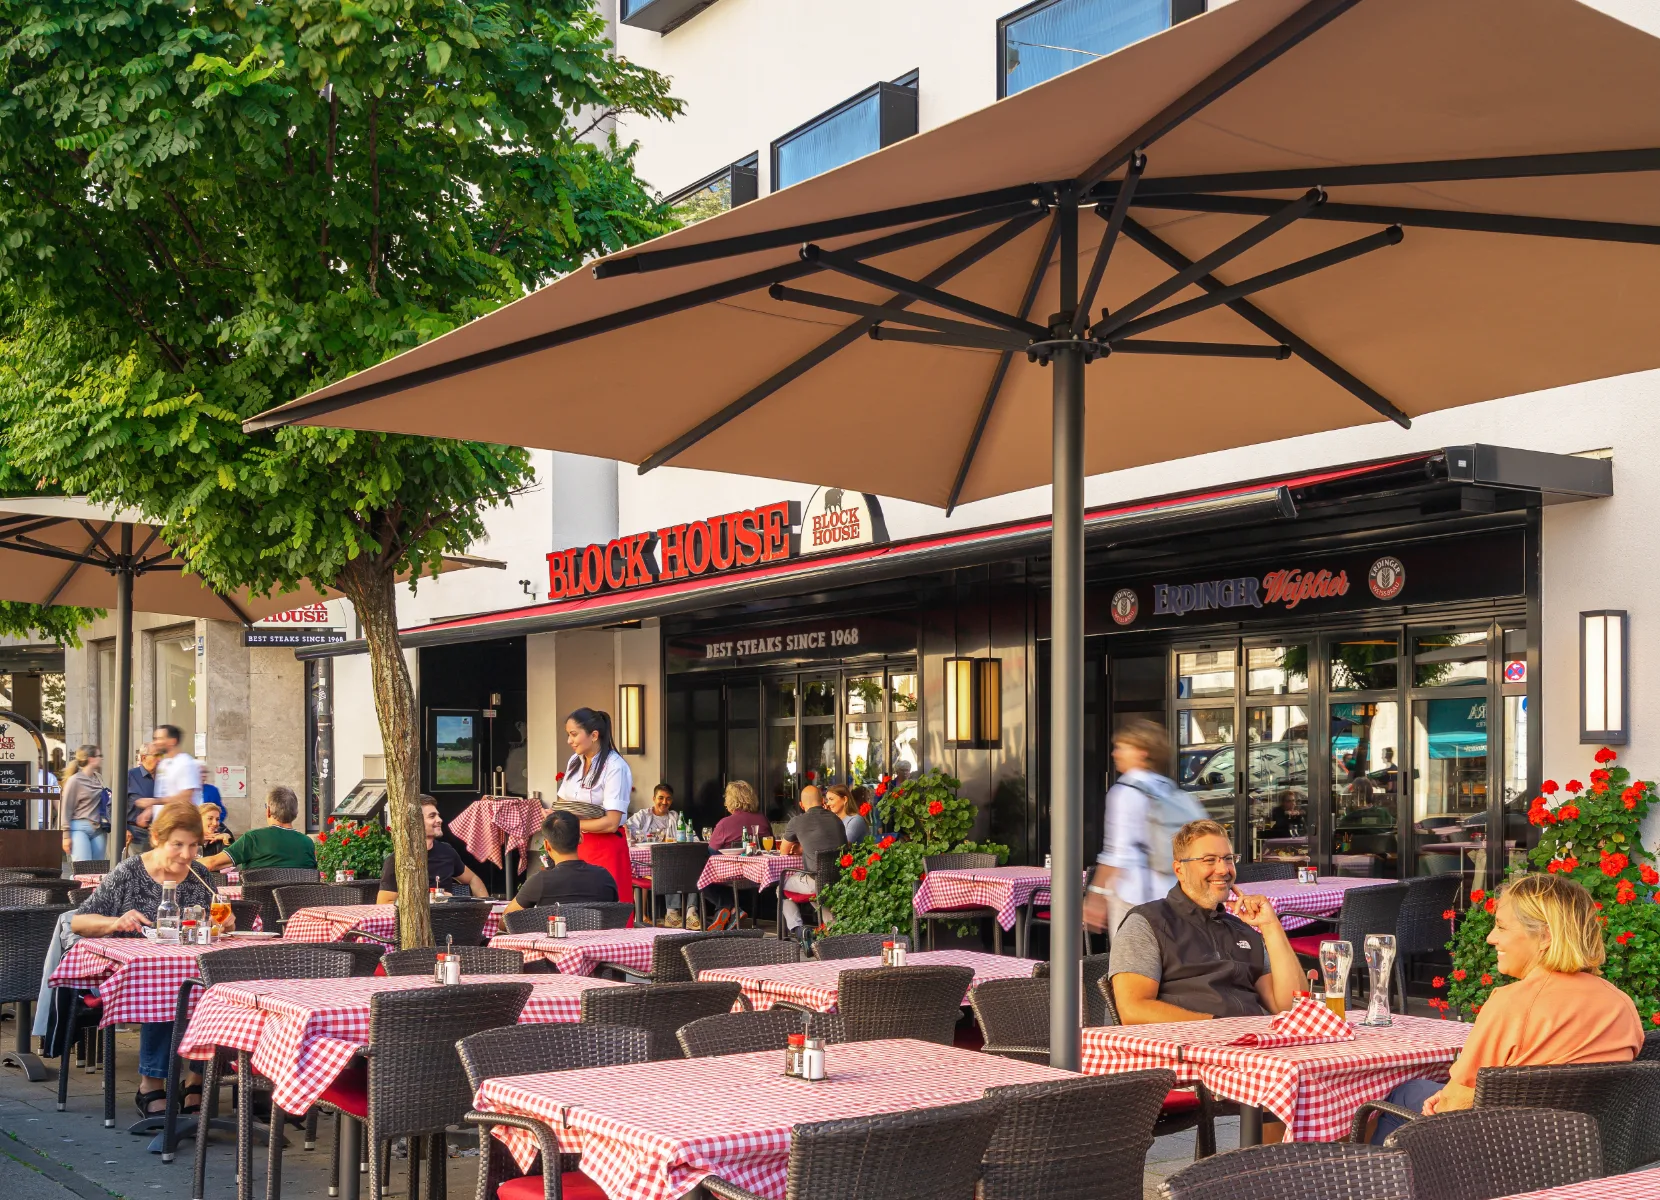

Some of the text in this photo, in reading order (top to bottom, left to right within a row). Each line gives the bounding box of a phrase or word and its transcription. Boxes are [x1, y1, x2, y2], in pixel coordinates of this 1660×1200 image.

[812, 507, 859, 531] BLOCK
[812, 523, 859, 546] HOUSE
[546, 501, 790, 600] BLOCK HOUSE
[1370, 559, 1401, 577] ERDINGER
[1153, 568, 1350, 616] ERDINGER Weißbier
[706, 628, 859, 659] BEST STEAKS SINCE 1968
